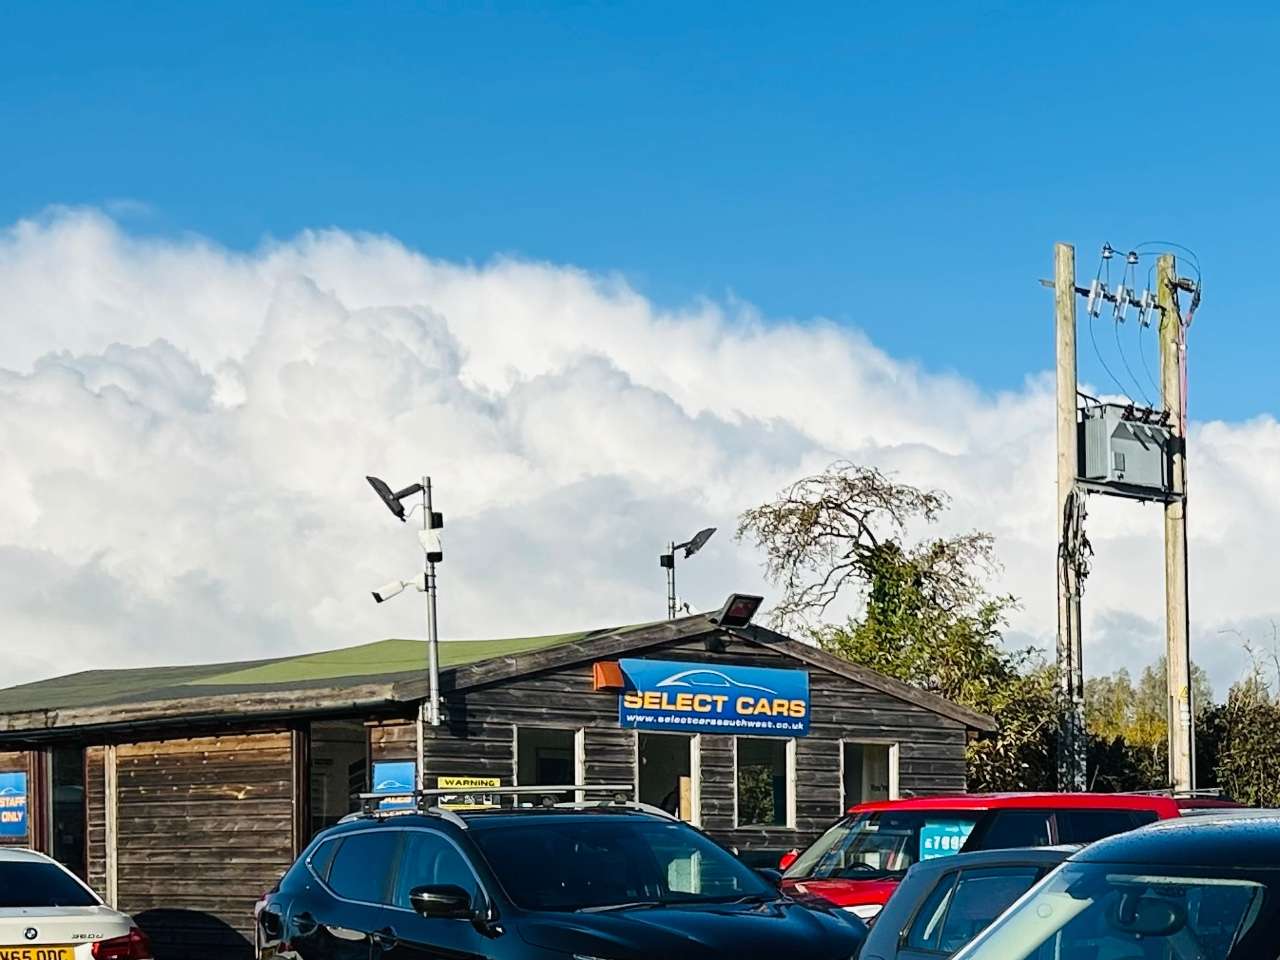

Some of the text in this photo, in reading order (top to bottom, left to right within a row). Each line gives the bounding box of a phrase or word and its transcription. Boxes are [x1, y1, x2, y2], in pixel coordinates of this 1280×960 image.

[624, 691, 806, 717] SELECT CARS
[444, 778, 496, 788] WARNING
[1, 811, 24, 823] ONLY
